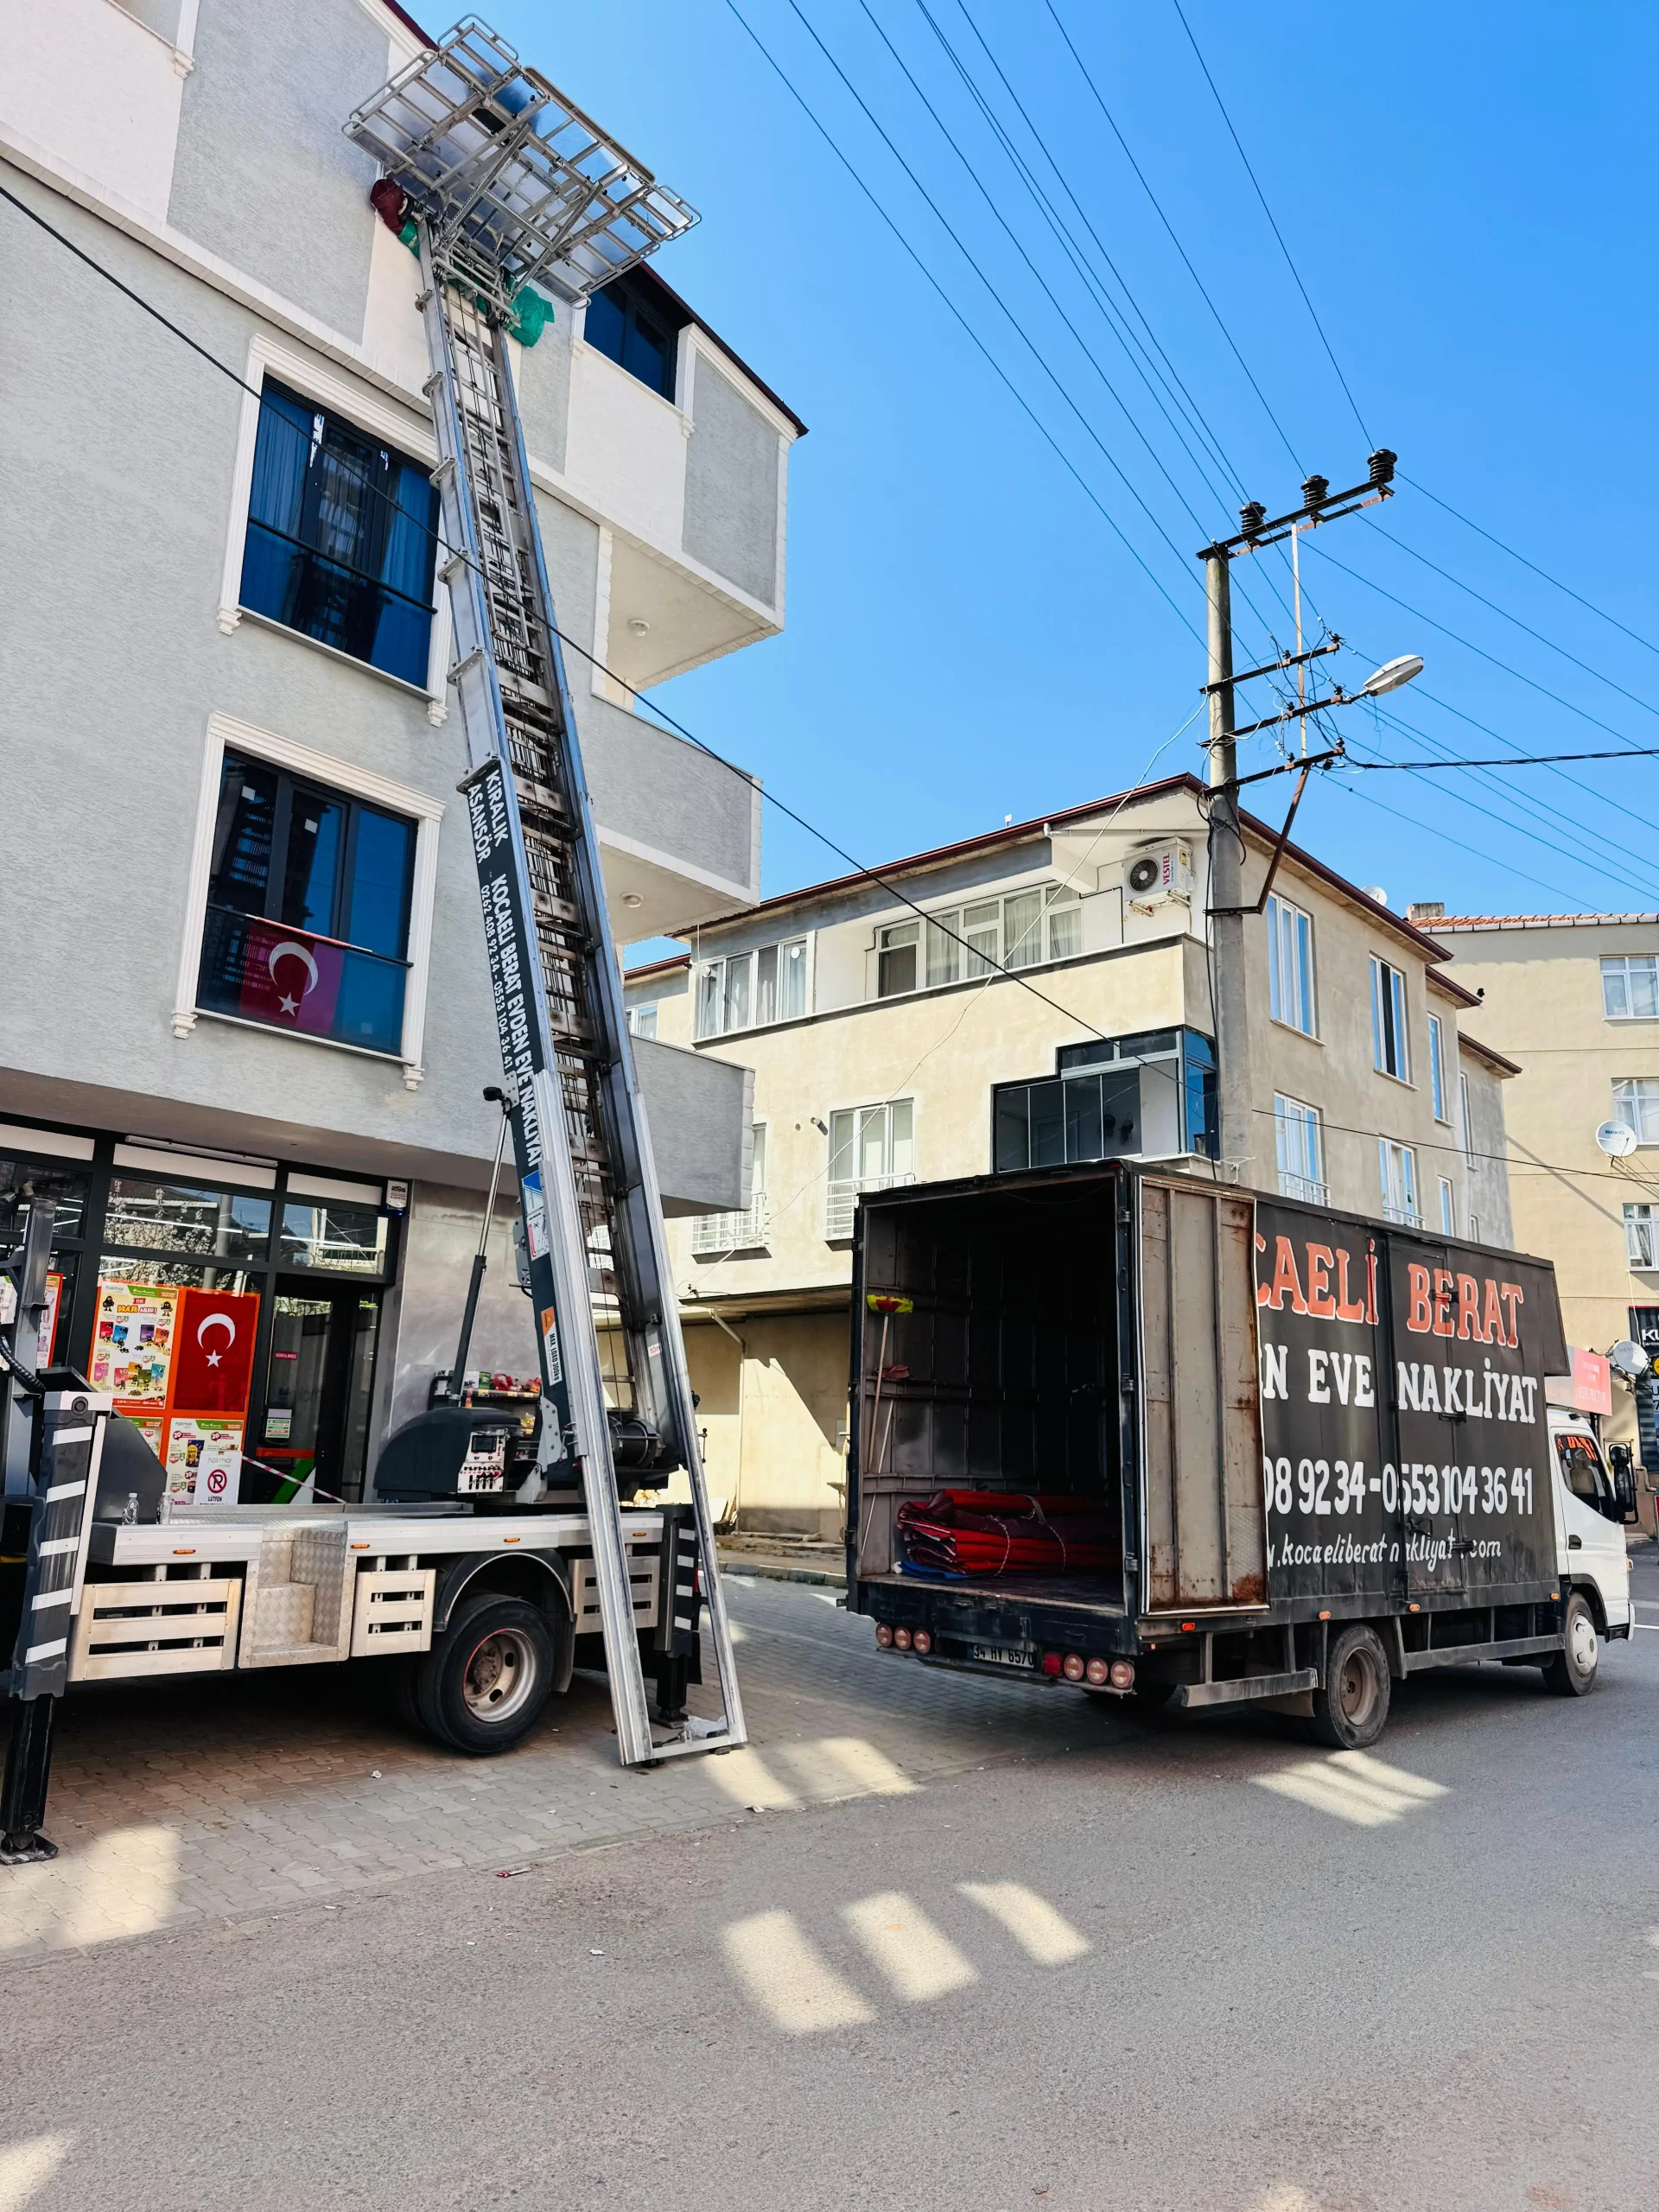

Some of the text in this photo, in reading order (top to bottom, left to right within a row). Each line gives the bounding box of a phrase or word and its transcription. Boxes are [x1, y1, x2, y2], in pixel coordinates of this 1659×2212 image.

[468, 783, 493, 864] ASANSÖR
[486, 769, 508, 847] KİRALIK
[481, 885, 492, 914] 0262
[491, 873, 516, 946] KOCAELİ
[486, 916, 495, 938] 408
[488, 938, 498, 955] 92
[490, 956, 500, 973] 34
[500, 942, 522, 995] BERAT
[493, 981, 505, 1011] 0553
[498, 1012, 508, 1034] 104
[507, 993, 531, 1053] EVDEN
[500, 1037, 512, 1053] 36
[504, 1056, 513, 1070] 41
[515, 1053, 534, 1087] EVE
[1407, 1263, 1523, 1349] BERAT
[1307, 1348, 1375, 1408] EVE
[1397, 1357, 1538, 1424] NAKLİYAT
[1510, 1467, 1533, 1515] 41
[974, 1644, 986, 1658] 34
